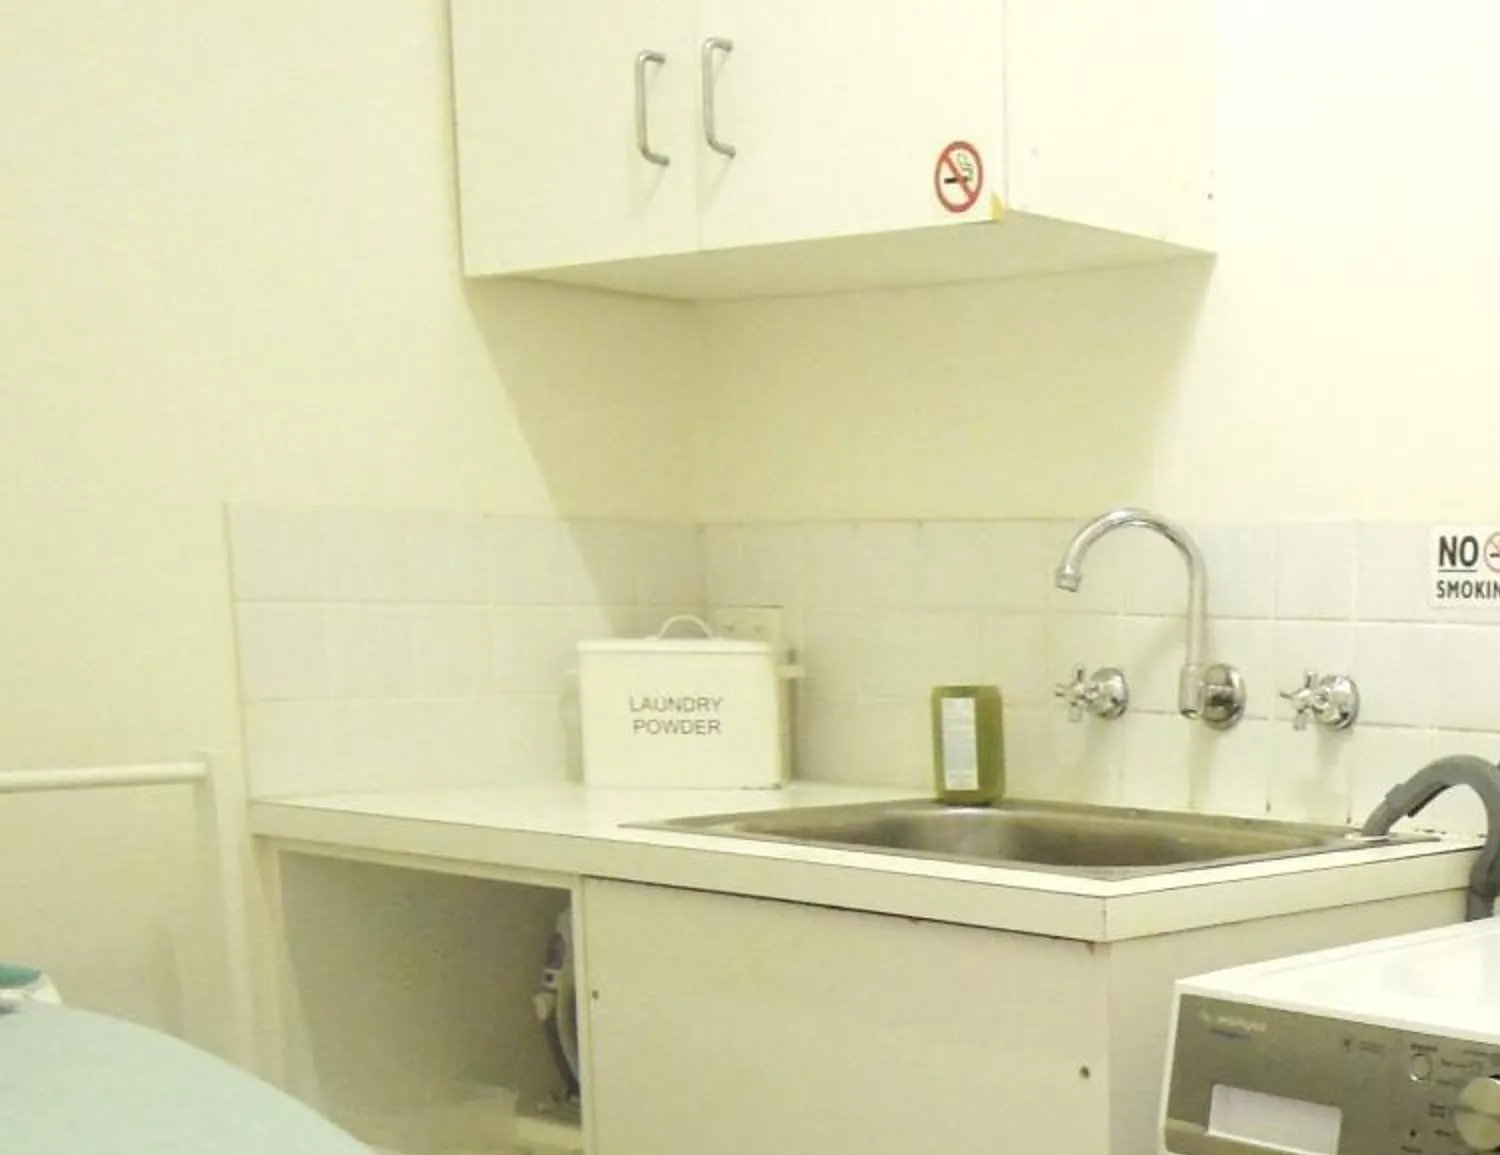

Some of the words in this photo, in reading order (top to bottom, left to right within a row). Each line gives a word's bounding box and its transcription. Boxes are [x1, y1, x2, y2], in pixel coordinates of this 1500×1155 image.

[1438, 535, 1479, 567] NO
[629, 696, 724, 713] LAUNDRY
[632, 719, 722, 735] POWDER
